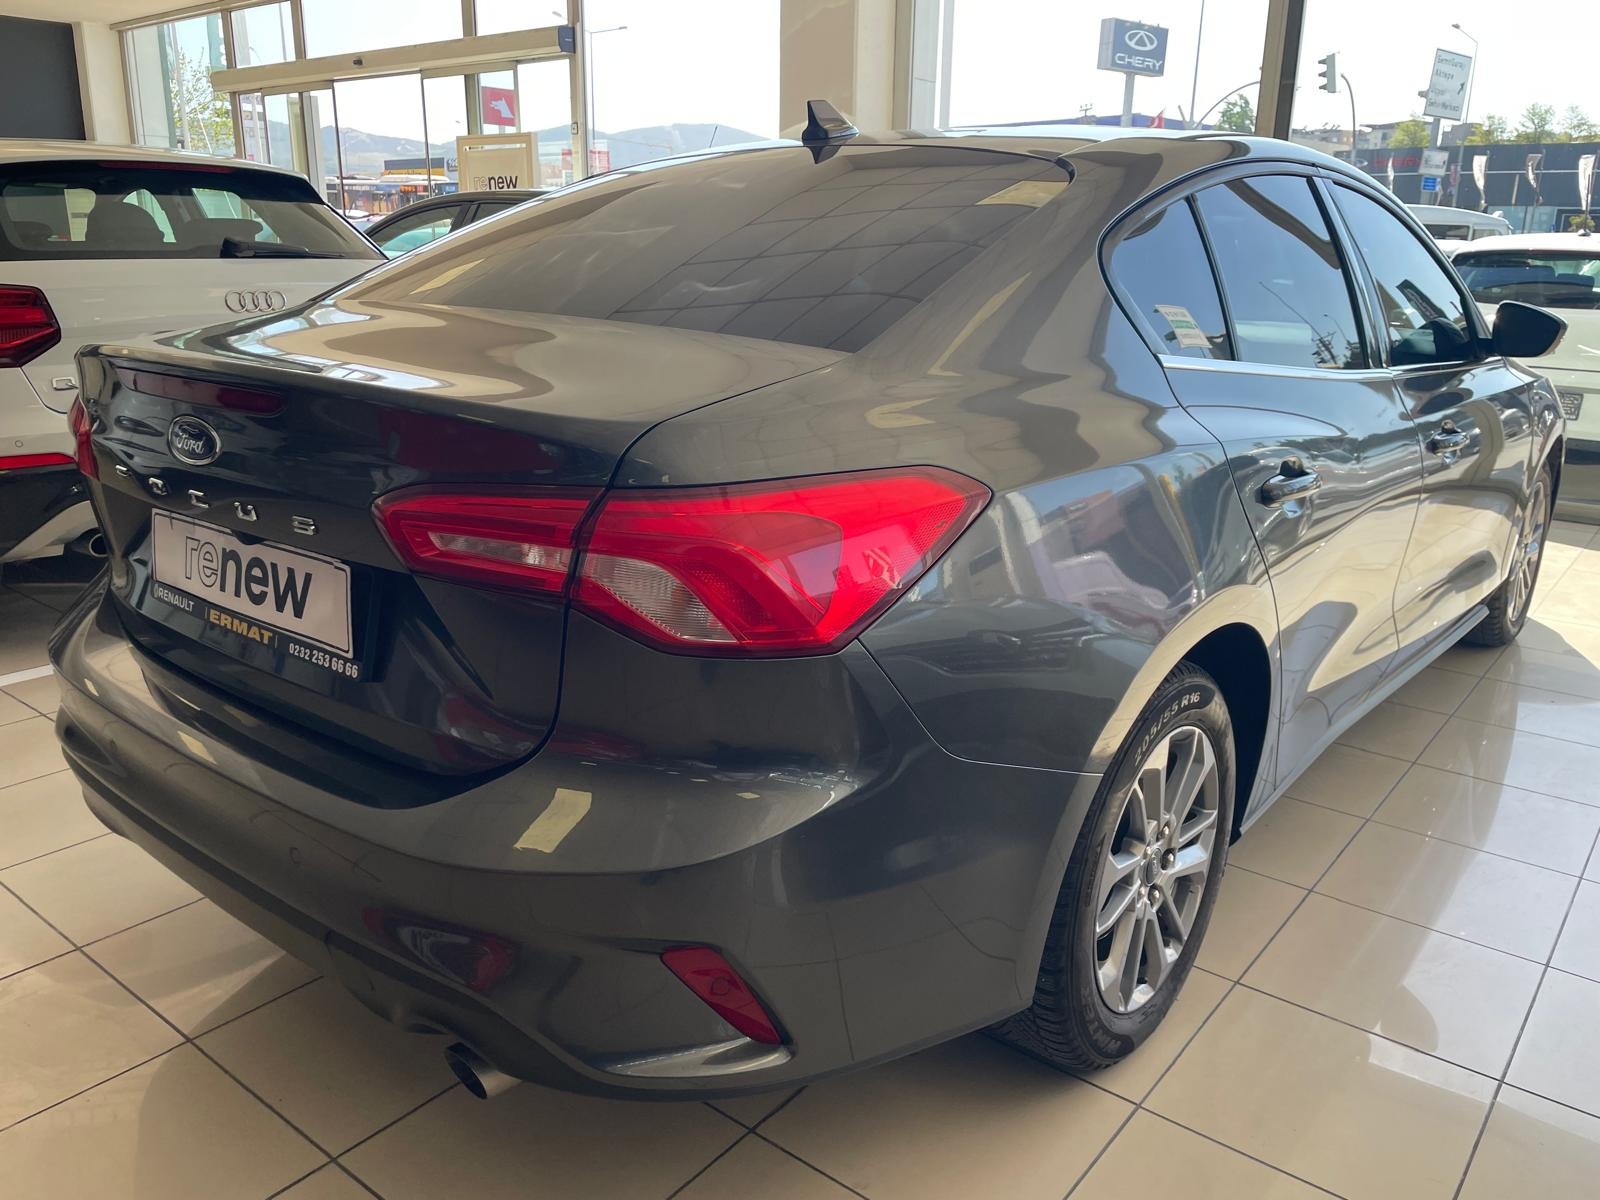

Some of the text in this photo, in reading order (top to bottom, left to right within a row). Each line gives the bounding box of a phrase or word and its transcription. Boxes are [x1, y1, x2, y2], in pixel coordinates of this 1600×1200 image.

[1115, 53, 1163, 70] CHERY
[474, 174, 518, 191] renew
[176, 425, 205, 455] Ford
[115, 464, 317, 536] FOCUS
[185, 535, 313, 620] renew
[158, 587, 359, 679] RENAULT ERMAT 0232 253 66 66
[1134, 691, 1201, 767] 205/55 R16
